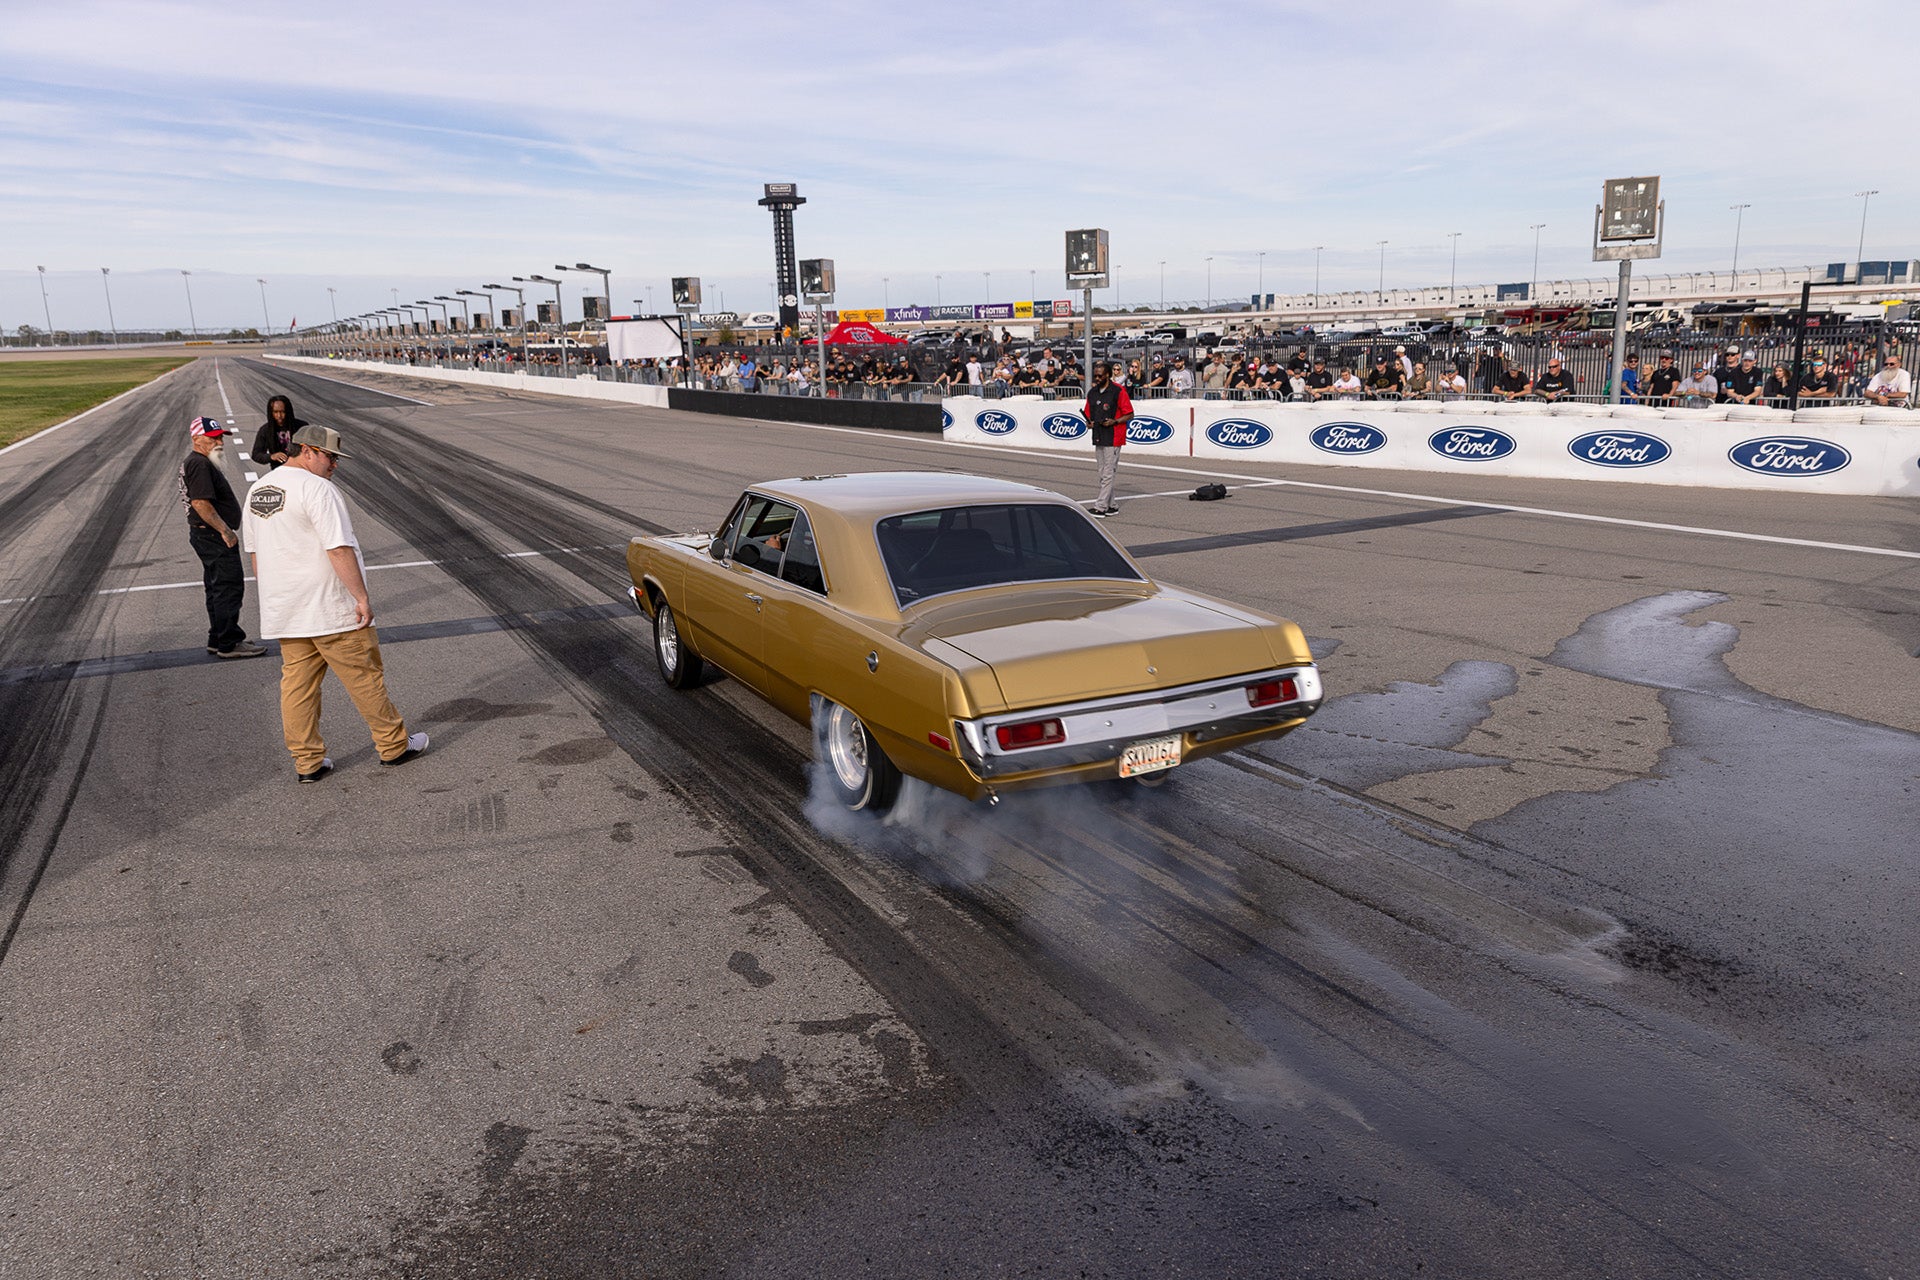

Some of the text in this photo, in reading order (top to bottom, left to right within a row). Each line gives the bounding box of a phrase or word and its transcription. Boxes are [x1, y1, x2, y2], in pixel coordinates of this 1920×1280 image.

[701, 313, 735, 322] GRIZZLY
[893, 308, 922, 320] xfinity
[941, 306, 972, 314] RACKLEY
[983, 413, 1008, 431] Ford
[1050, 416, 1078, 436] Ford
[1126, 419, 1161, 440] Ford
[1218, 422, 1259, 444] Ford
[1324, 426, 1372, 449] Ford
[1445, 431, 1498, 456] Ford
[1588, 435, 1651, 462] Ford
[1751, 441, 1826, 470] Ford
